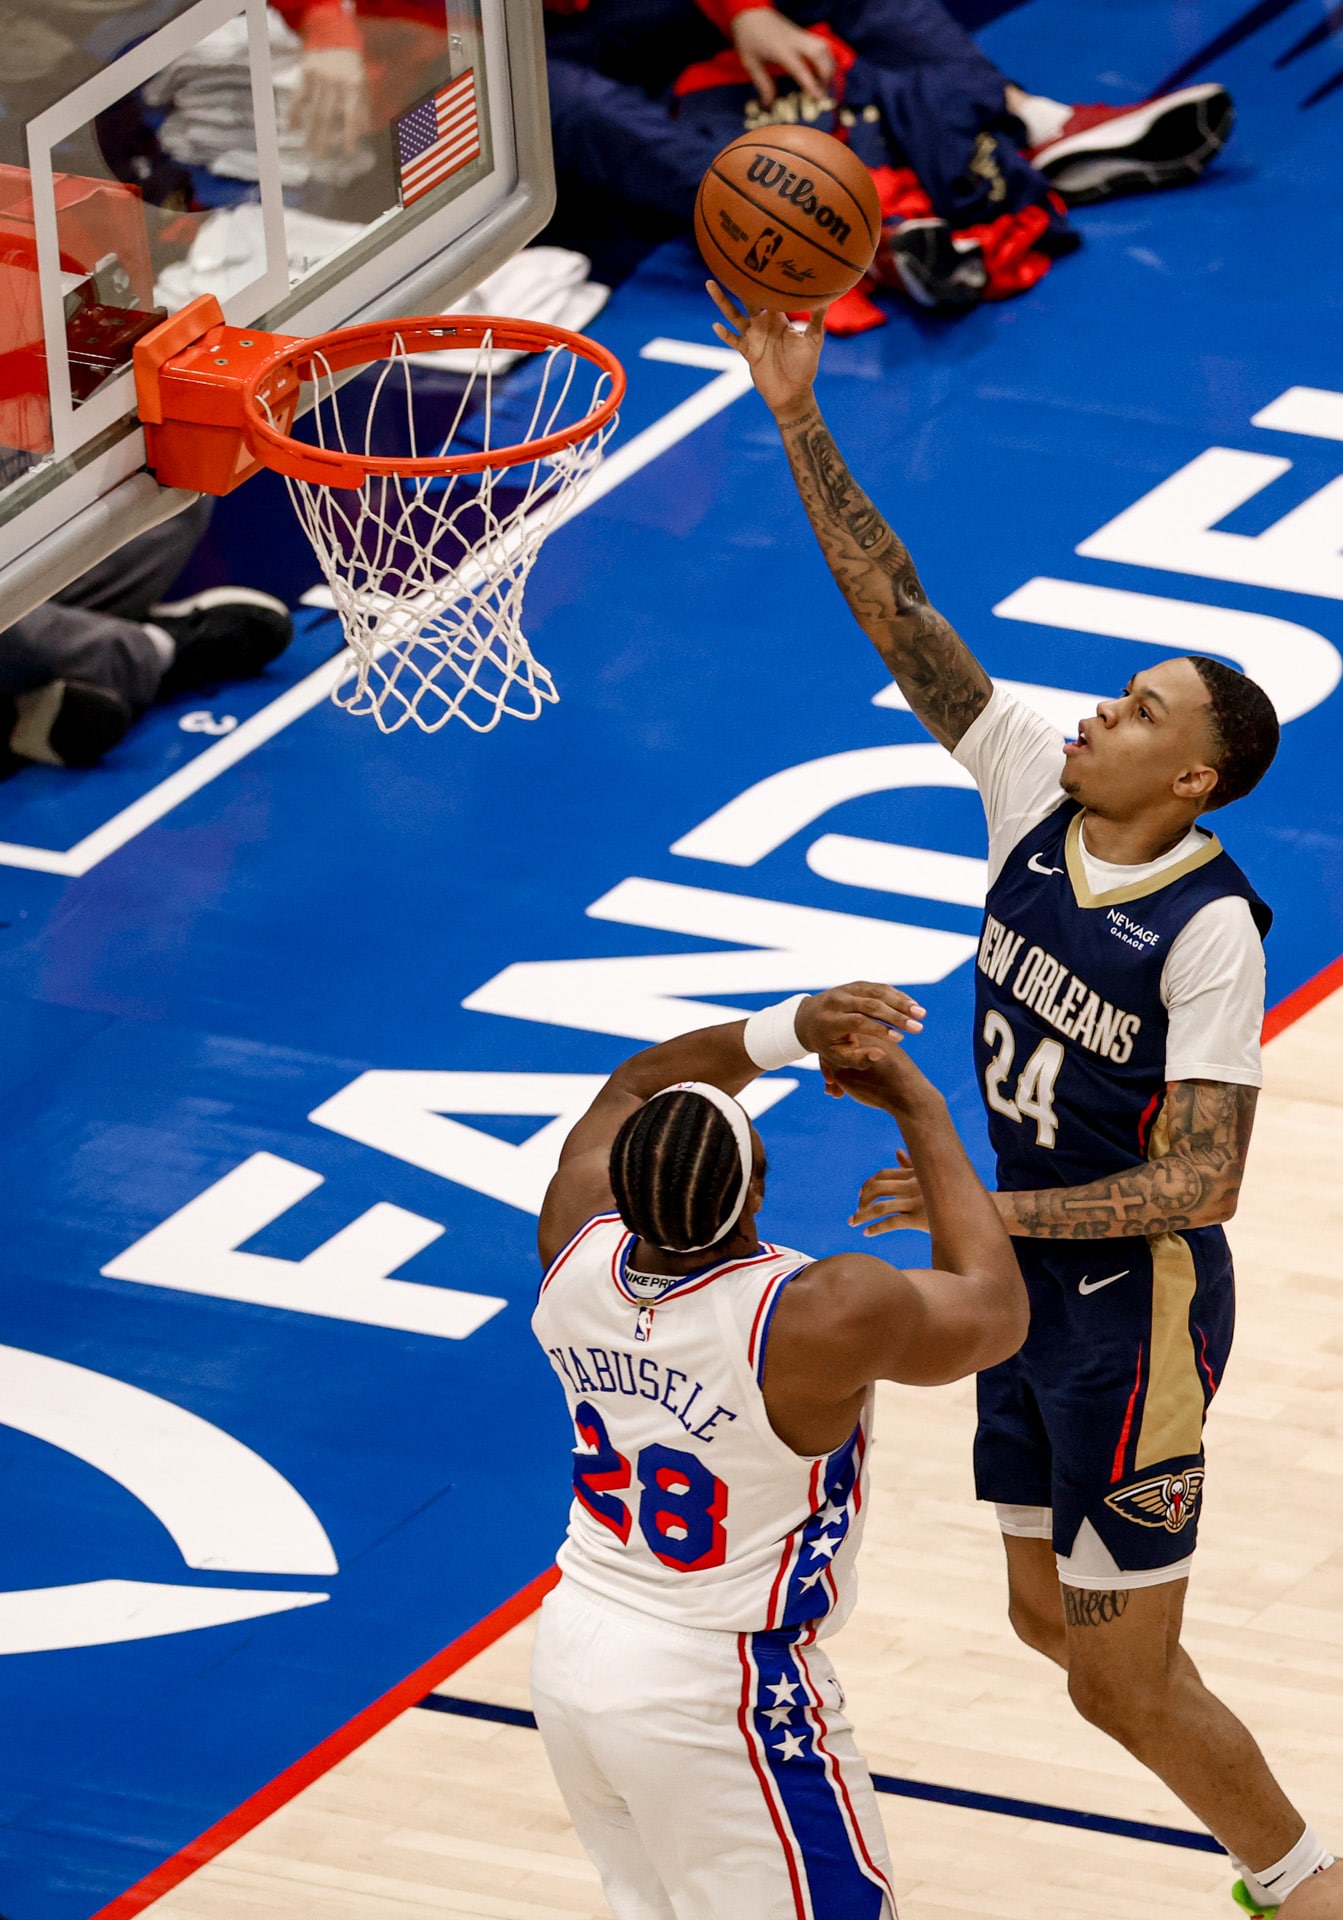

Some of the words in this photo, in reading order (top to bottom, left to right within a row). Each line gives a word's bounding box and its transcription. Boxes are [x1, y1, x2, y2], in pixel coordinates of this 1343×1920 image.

[747, 154, 852, 246] Wilson
[1106, 908, 1160, 946] NEWAGE
[1110, 927, 1144, 951] GARAGE
[1012, 945, 1142, 1065] ORLEANS
[982, 1009, 1065, 1150] 24
[549, 1346, 738, 1443] YABUSELE
[572, 1400, 729, 1574] 28
